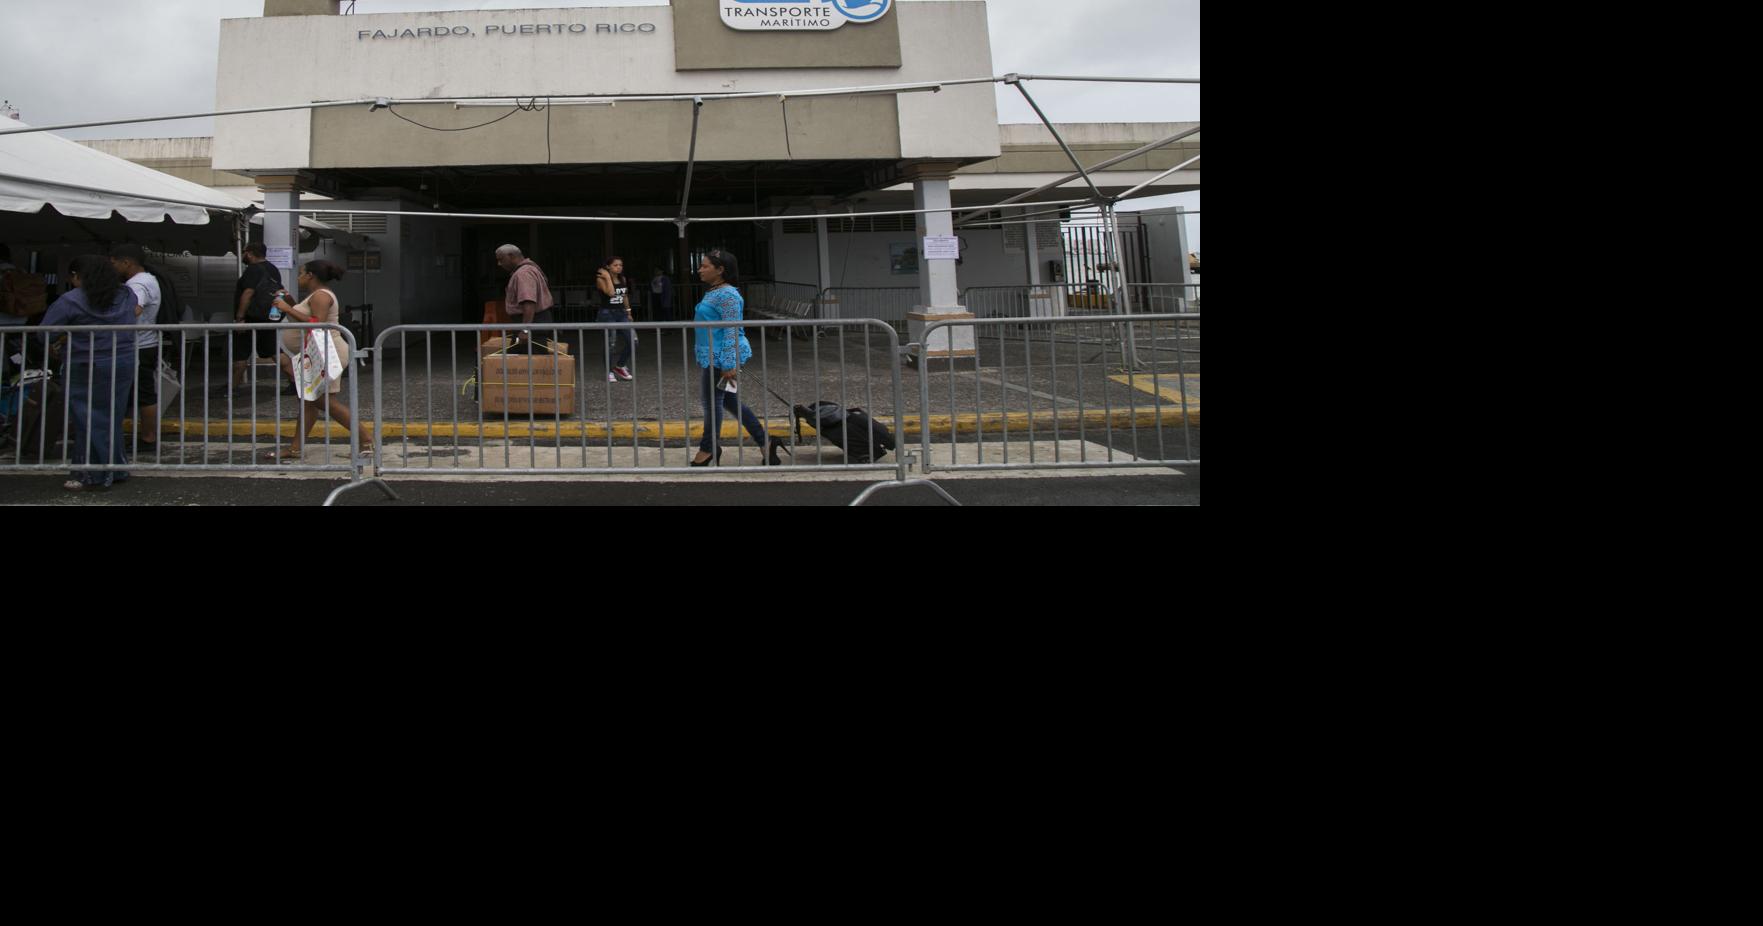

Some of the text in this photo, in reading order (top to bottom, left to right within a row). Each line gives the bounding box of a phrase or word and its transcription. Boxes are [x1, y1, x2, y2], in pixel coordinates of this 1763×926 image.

[724, 7, 831, 17] TRANSPORTE
[358, 22, 656, 41] FAJARDO, PUERTO RICO
